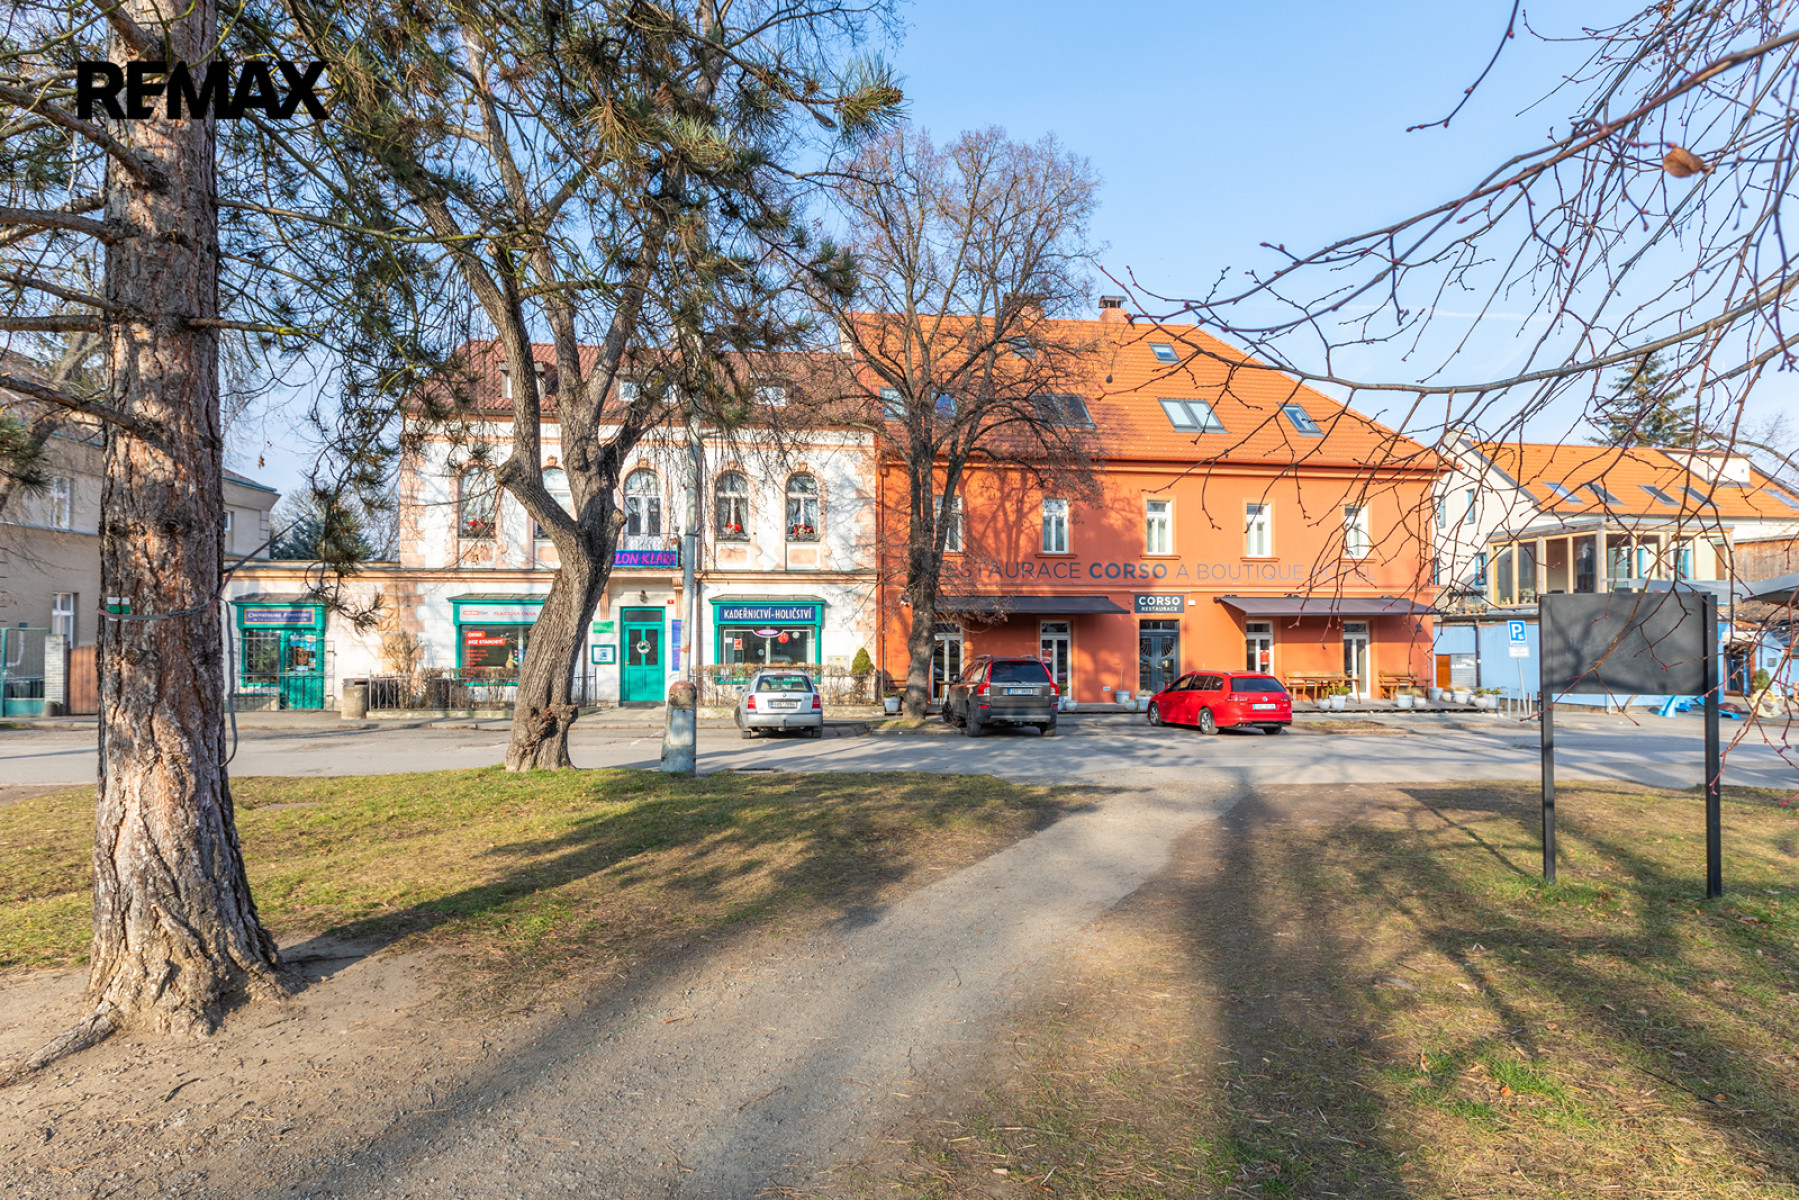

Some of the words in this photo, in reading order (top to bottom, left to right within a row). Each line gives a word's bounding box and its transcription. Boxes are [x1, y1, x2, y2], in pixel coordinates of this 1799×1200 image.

[615, 553, 638, 565] LON
[642, 551, 676, 566] KLÁRA
[946, 561, 1081, 580] ESTAURACE
[1089, 562, 1168, 580] CORSO
[1176, 563, 1190, 580] A
[1197, 563, 1304, 581] BOUTIQUE
[1311, 564, 1377, 581] HOTEL
[1138, 596, 1181, 606] CORSO
